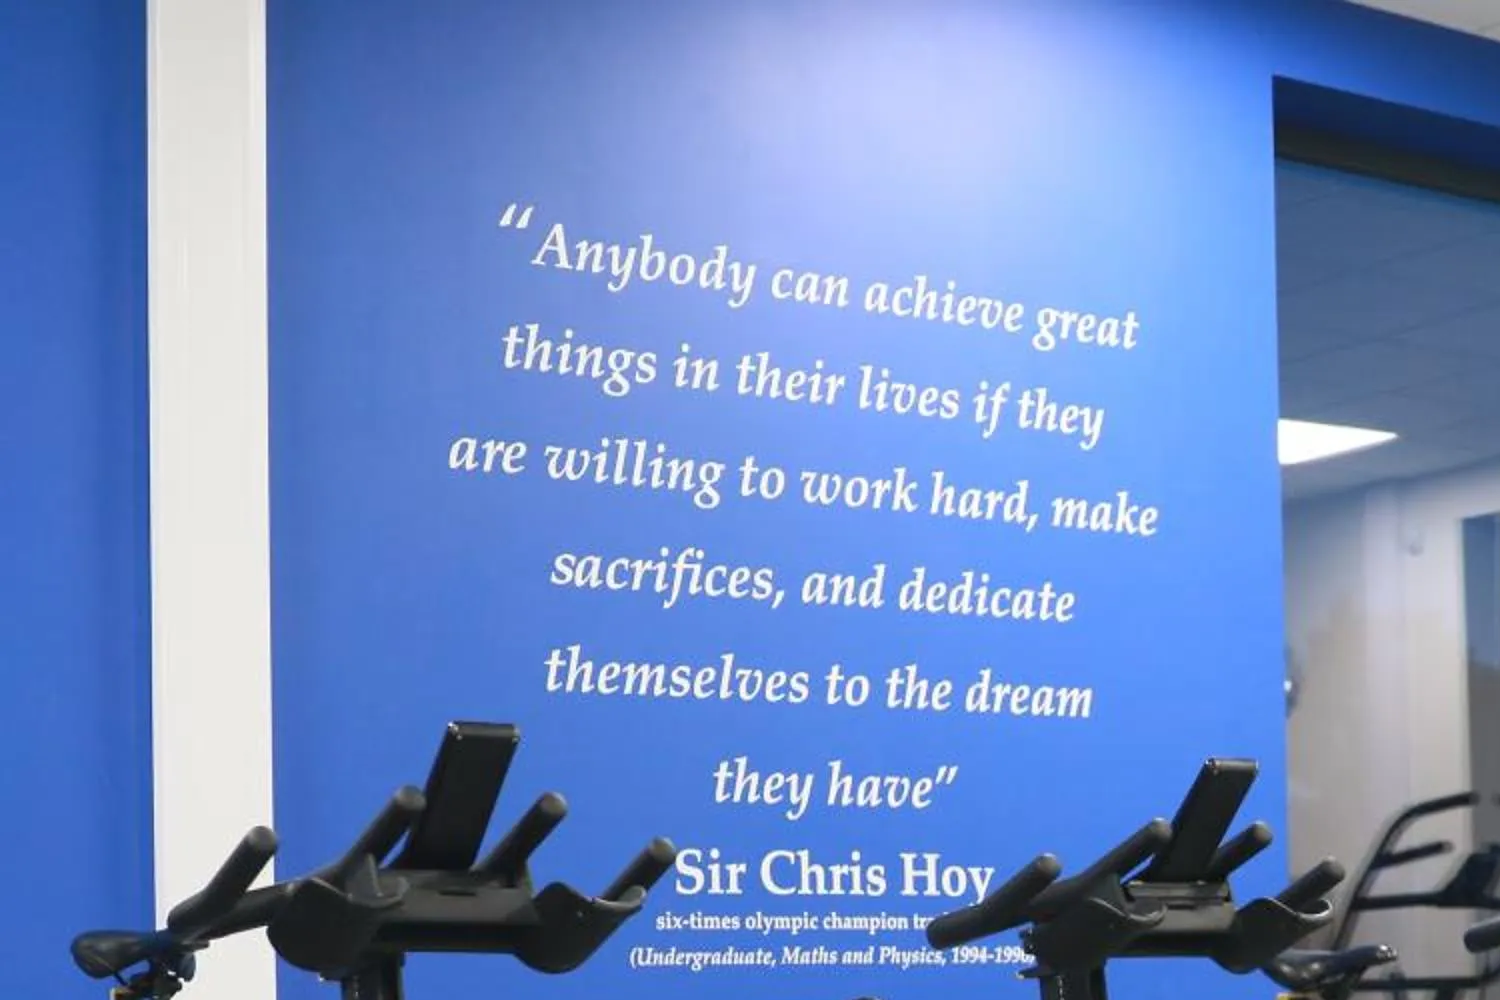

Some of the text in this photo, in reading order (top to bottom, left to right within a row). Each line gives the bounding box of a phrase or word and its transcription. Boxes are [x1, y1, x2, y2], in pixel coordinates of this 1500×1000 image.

[771, 269, 849, 308] can
[864, 275, 1025, 332] achieve
[1031, 307, 1140, 352] great
[502, 323, 1105, 451] things in their lives if they
[448, 437, 1158, 536] are willing to work hard, make
[550, 546, 1075, 623] sacrifices, and dedicate
[543, 644, 1093, 718] themselves to the dream
[713, 755, 958, 821] they have”
[675, 847, 995, 907] Sir Chris Hoy
[629, 946, 777, 972] (Undergraduate,
[780, 945, 839, 965] Maths
[841, 945, 875, 965] and
[878, 945, 947, 970] Physics,
[655, 911, 741, 931] six-times
[744, 911, 819, 936] olympic
[822, 911, 909, 936] champion
